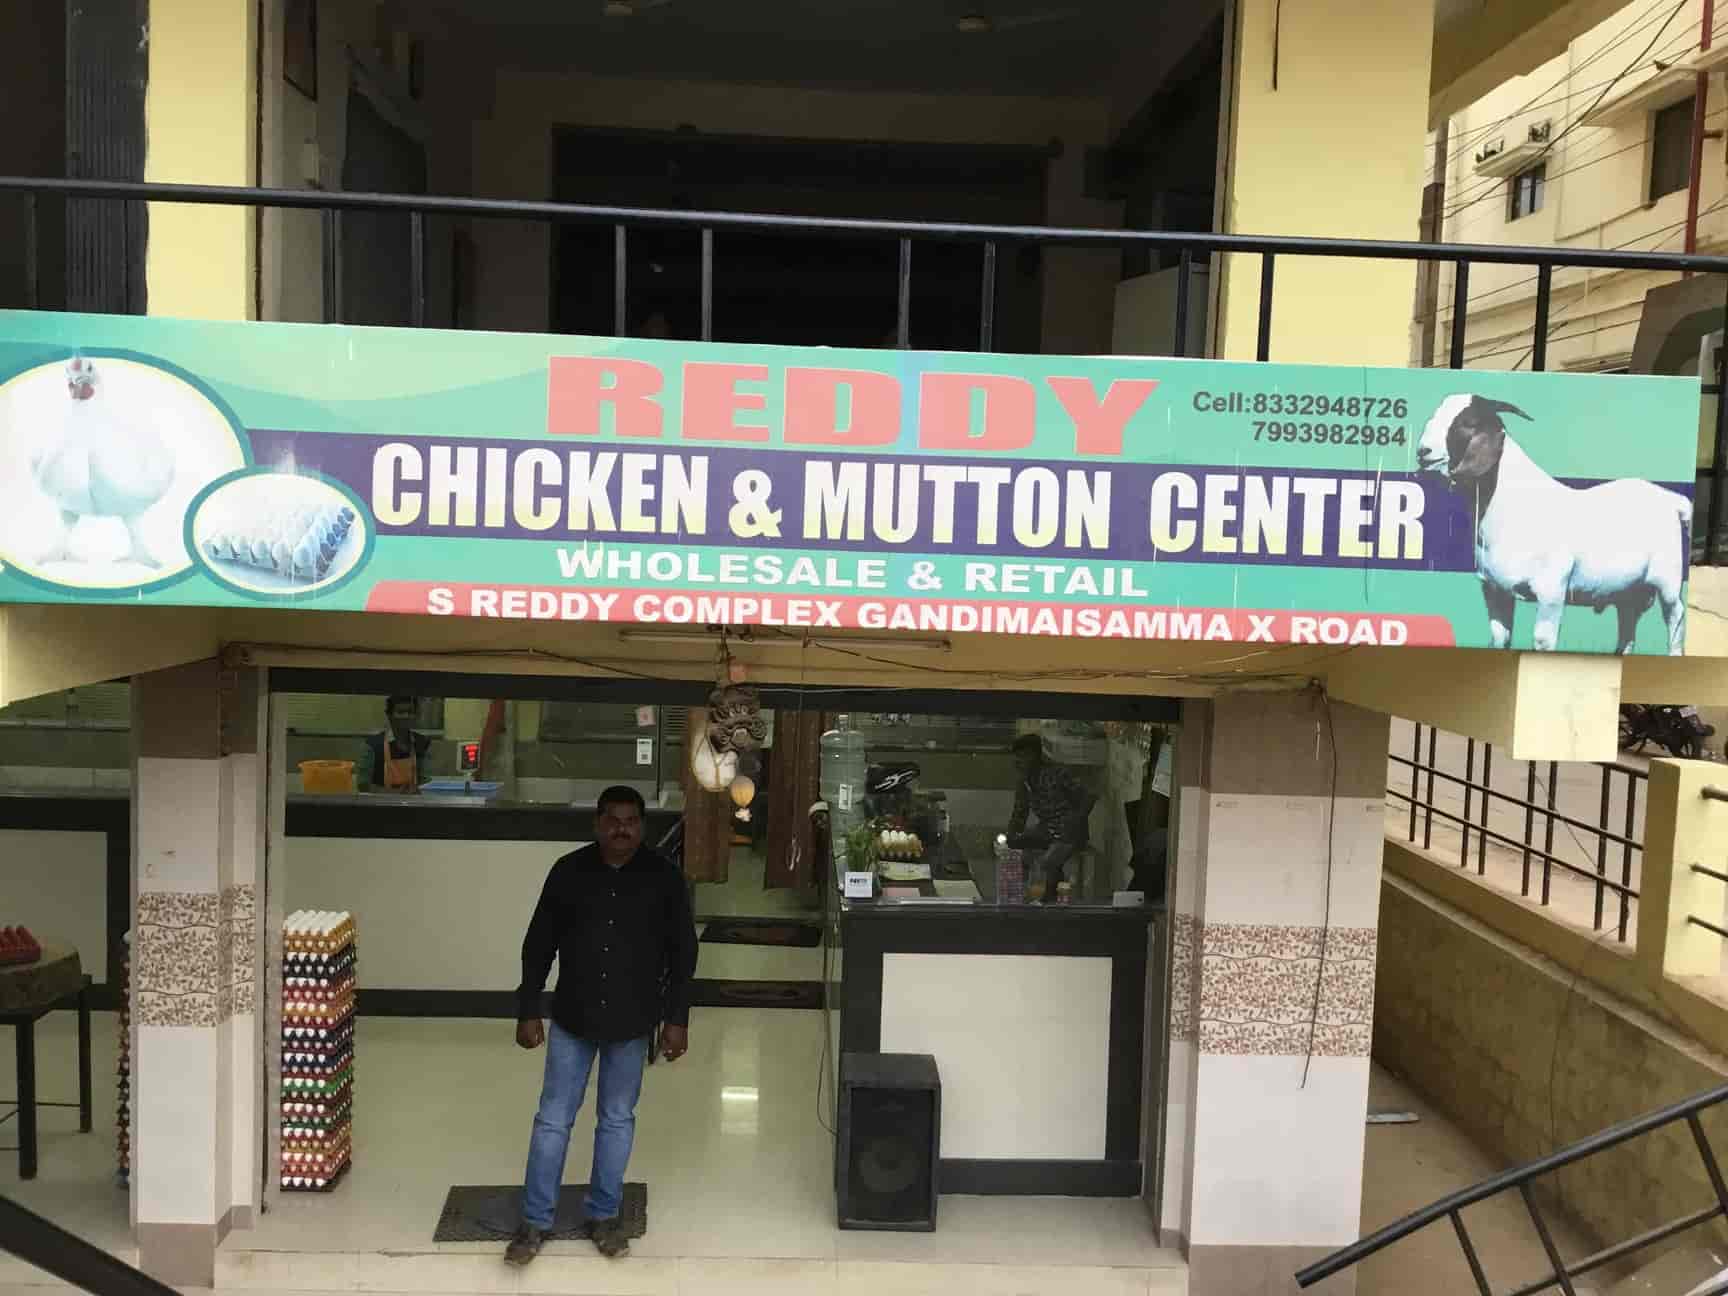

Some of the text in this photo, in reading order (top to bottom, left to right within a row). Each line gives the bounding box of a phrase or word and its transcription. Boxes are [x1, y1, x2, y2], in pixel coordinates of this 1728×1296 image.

[547, 355, 1160, 456] REDDY
[1193, 391, 1408, 418] Cell:8332948726
[1252, 421, 1406, 446] 7993982984
[372, 442, 1426, 561] CHICKEN & MUTTON CENTER
[557, 548, 1148, 598] WHOLESALE & RETAIL
[426, 588, 1409, 647] S REDDY COMPLEX GANDIMAISAMMA X ROAD
